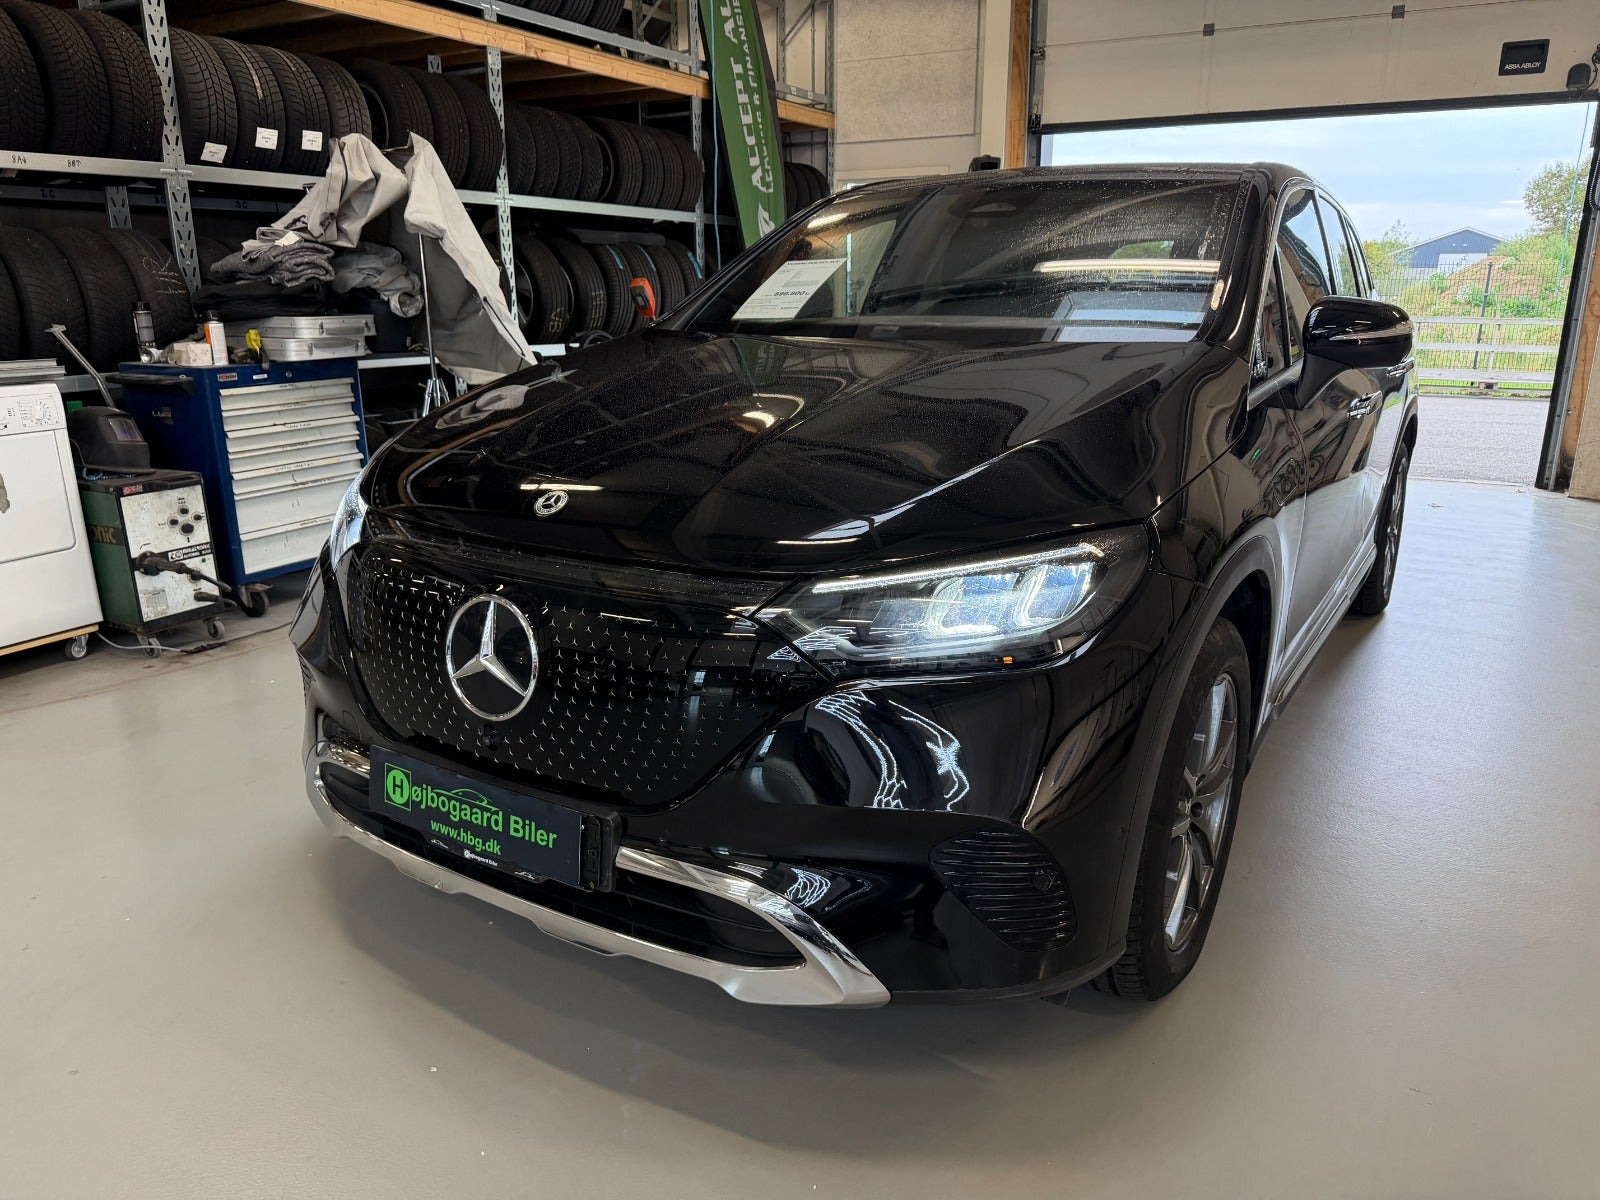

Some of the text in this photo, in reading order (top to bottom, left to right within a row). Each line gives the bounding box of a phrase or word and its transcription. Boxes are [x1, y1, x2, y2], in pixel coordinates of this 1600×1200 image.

[1521, 61, 1541, 69] ABLOY
[731, 57, 768, 192] ACCEPT
[386, 769, 558, 849] Højbogaard Biler
[430, 819, 502, 856] www.hbg.dk
